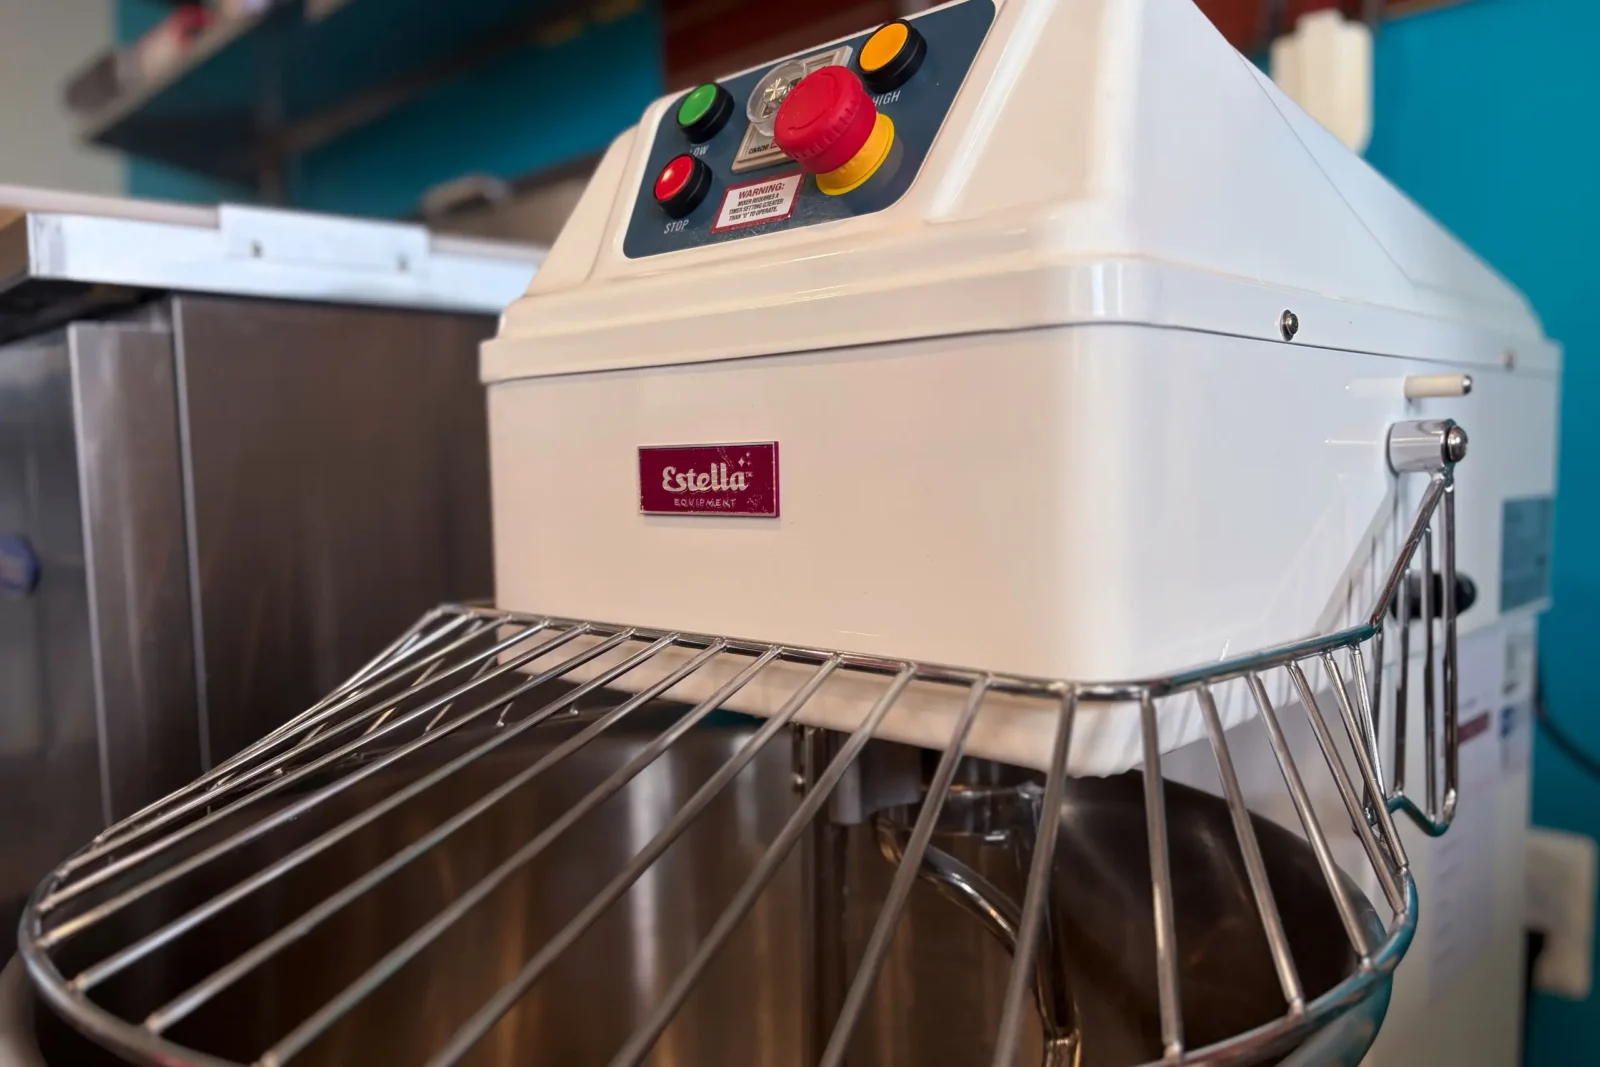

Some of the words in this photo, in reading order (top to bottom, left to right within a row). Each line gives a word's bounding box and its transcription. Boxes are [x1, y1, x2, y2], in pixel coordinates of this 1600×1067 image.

[689, 144, 710, 157] OW
[739, 183, 785, 199] WARNING:
[729, 207, 742, 215] TIMER
[743, 203, 762, 212] SETTING
[762, 198, 784, 208] GREATER
[738, 198, 752, 206] MIXER
[752, 194, 775, 204] REQUIRES
[729, 213, 741, 221] THAN
[756, 206, 777, 215] OPERATE.
[663, 218, 690, 235] STOP
[662, 462, 750, 493] Estella
[674, 498, 737, 508] EQUIPMENT
